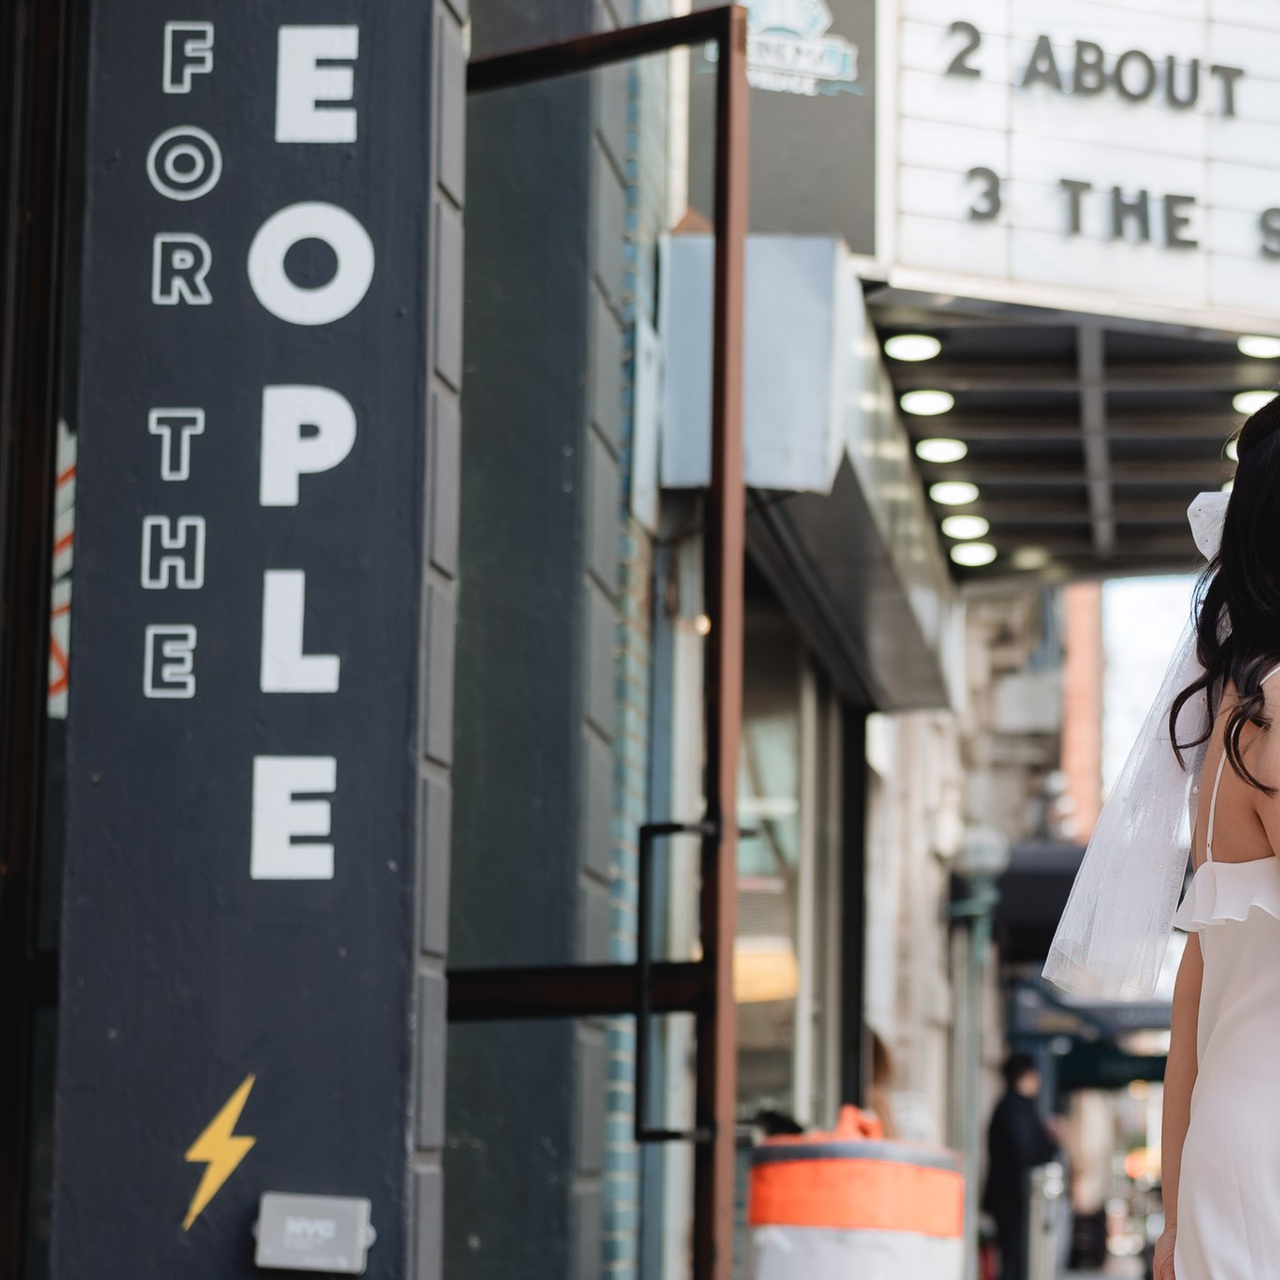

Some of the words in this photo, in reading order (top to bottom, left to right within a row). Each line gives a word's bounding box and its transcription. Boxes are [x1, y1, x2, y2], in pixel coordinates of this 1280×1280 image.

[146, 21, 222, 306] FOR
[946, 20, 982, 78] 2
[1021, 34, 1244, 118] ABOUT
[966, 166, 1001, 221] 3
[1059, 178, 1198, 249] THE
[141, 408, 205, 699] THE
